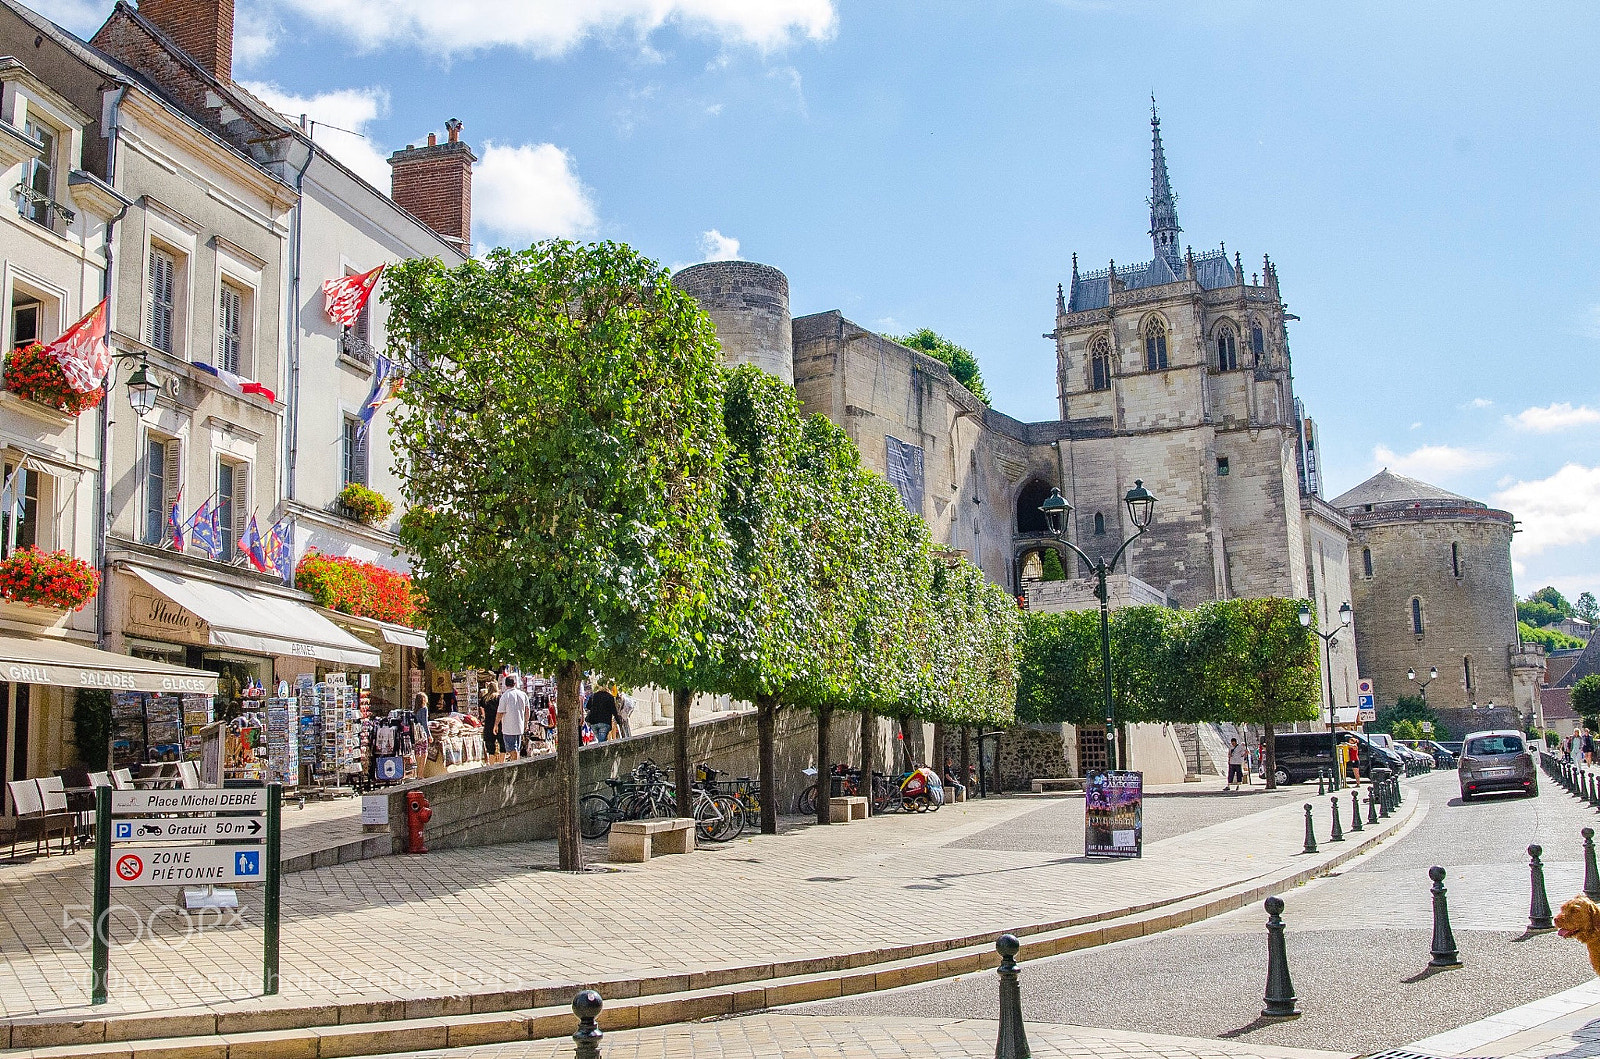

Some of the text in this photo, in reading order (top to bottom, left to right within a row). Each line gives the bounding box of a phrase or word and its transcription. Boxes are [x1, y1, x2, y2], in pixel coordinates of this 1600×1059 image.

[149, 598, 189, 627] Studio
[9, 666, 206, 691] GRILL SALADES GLACES
[147, 791, 258, 807] Place Michel DEBRÉ
[167, 823, 208, 835] Gratuit
[216, 822, 233, 834] 50
[234, 825, 245, 833] m
[152, 851, 191, 864] ZONE
[152, 866, 224, 880] PIÉTONNE
